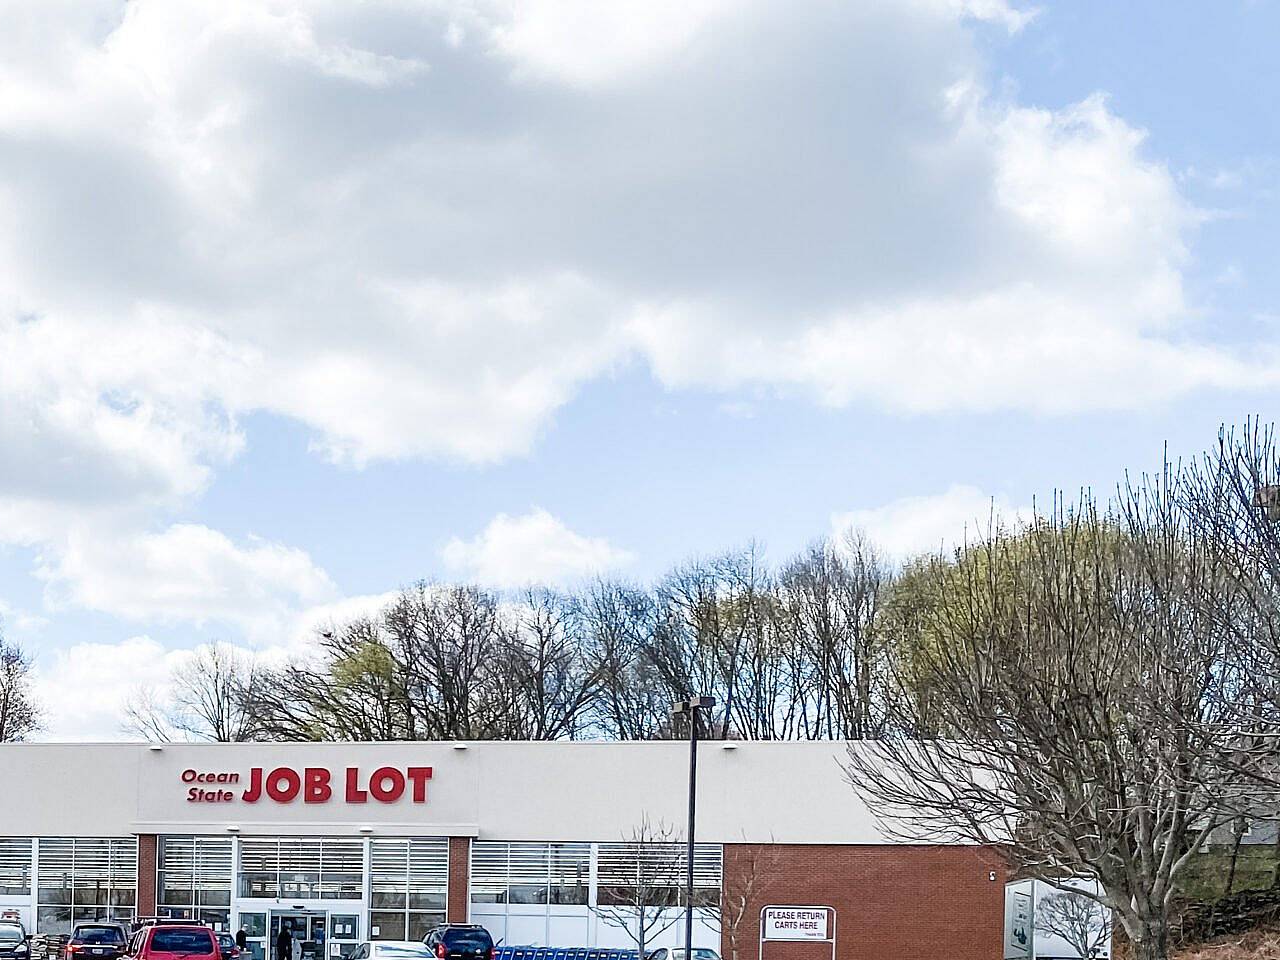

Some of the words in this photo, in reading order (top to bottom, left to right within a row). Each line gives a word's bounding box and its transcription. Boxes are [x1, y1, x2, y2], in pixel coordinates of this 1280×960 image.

[181, 769, 240, 784] Ocean
[242, 767, 332, 803] JOB
[346, 767, 433, 803] LOT
[186, 787, 234, 802] State
[768, 911, 795, 920] PLEASE
[797, 911, 825, 920] RETURN
[774, 921, 798, 929] CARTS
[800, 921, 818, 930] HERE
